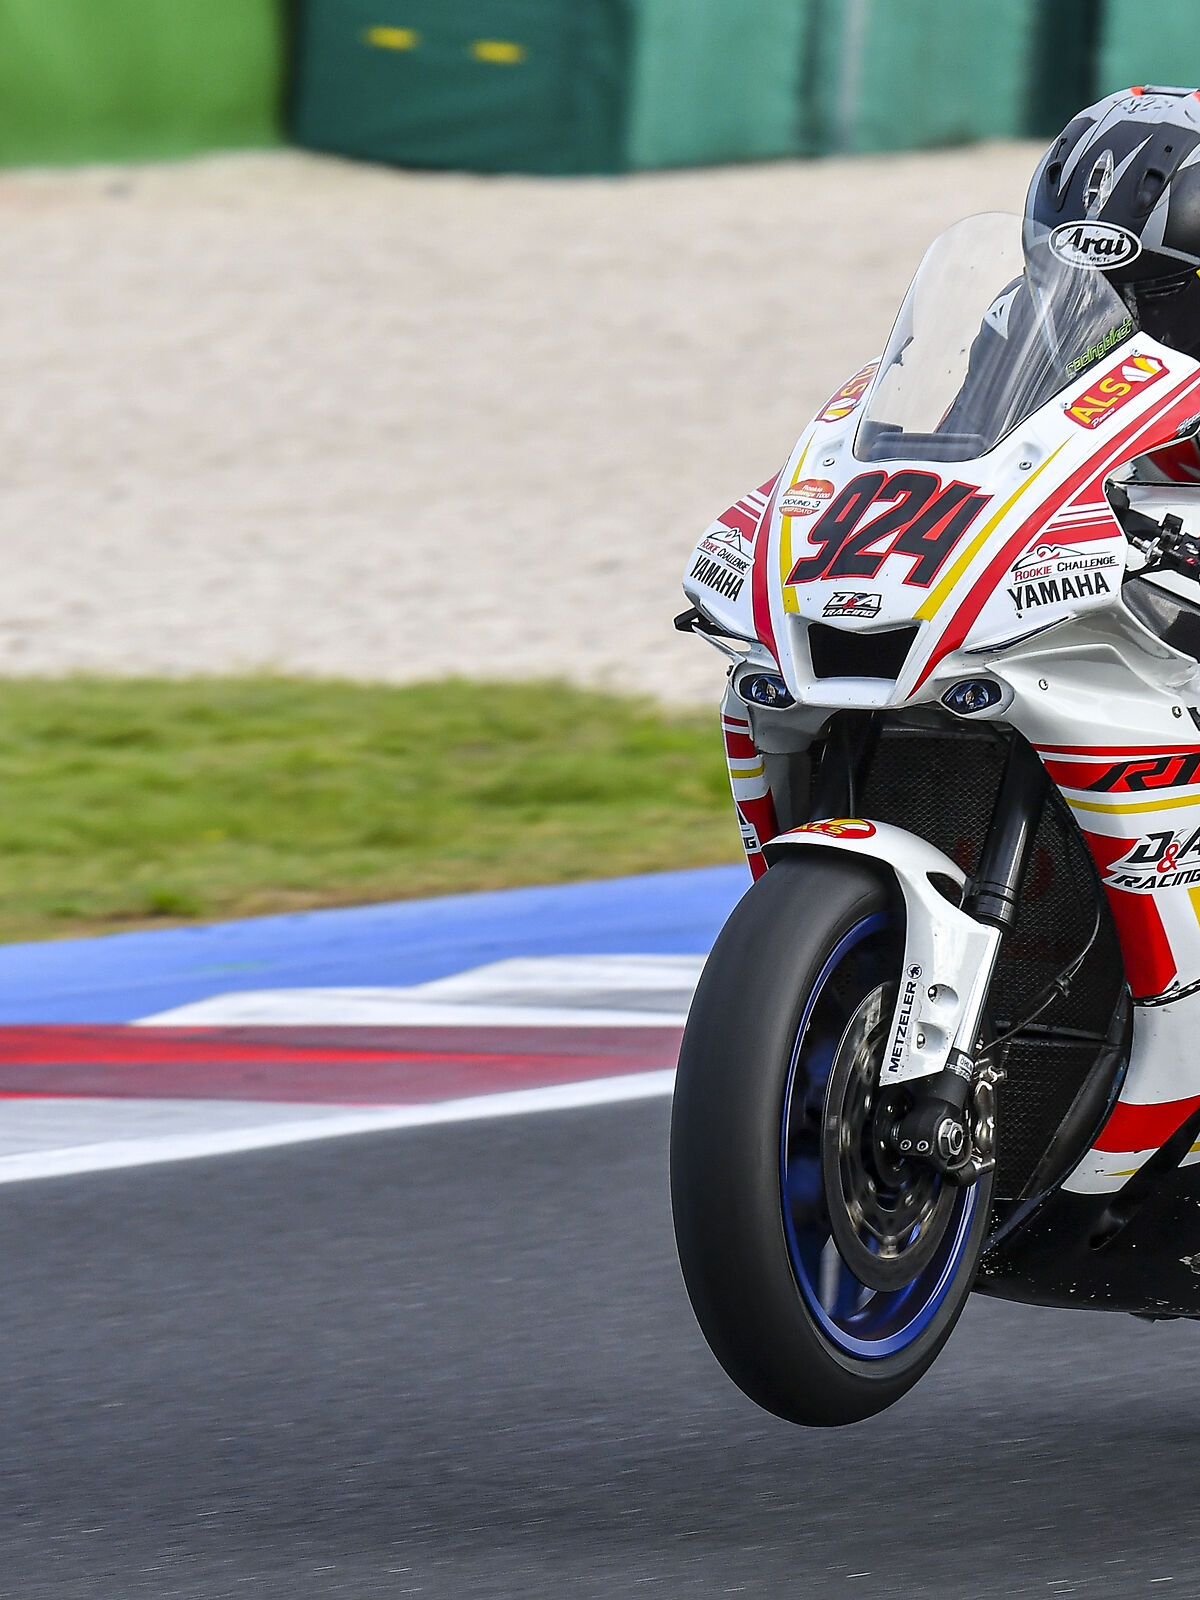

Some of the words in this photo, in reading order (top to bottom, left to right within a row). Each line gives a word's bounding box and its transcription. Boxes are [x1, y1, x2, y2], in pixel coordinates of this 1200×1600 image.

[1056, 228, 1127, 256] Arai
[1071, 378, 1131, 424] ALS
[812, 500, 821, 508] 3
[785, 469, 995, 588] 924
[690, 554, 744, 602] YAMAHA
[1007, 571, 1111, 611] YAMAHA
[888, 981, 917, 1073] METZELER
